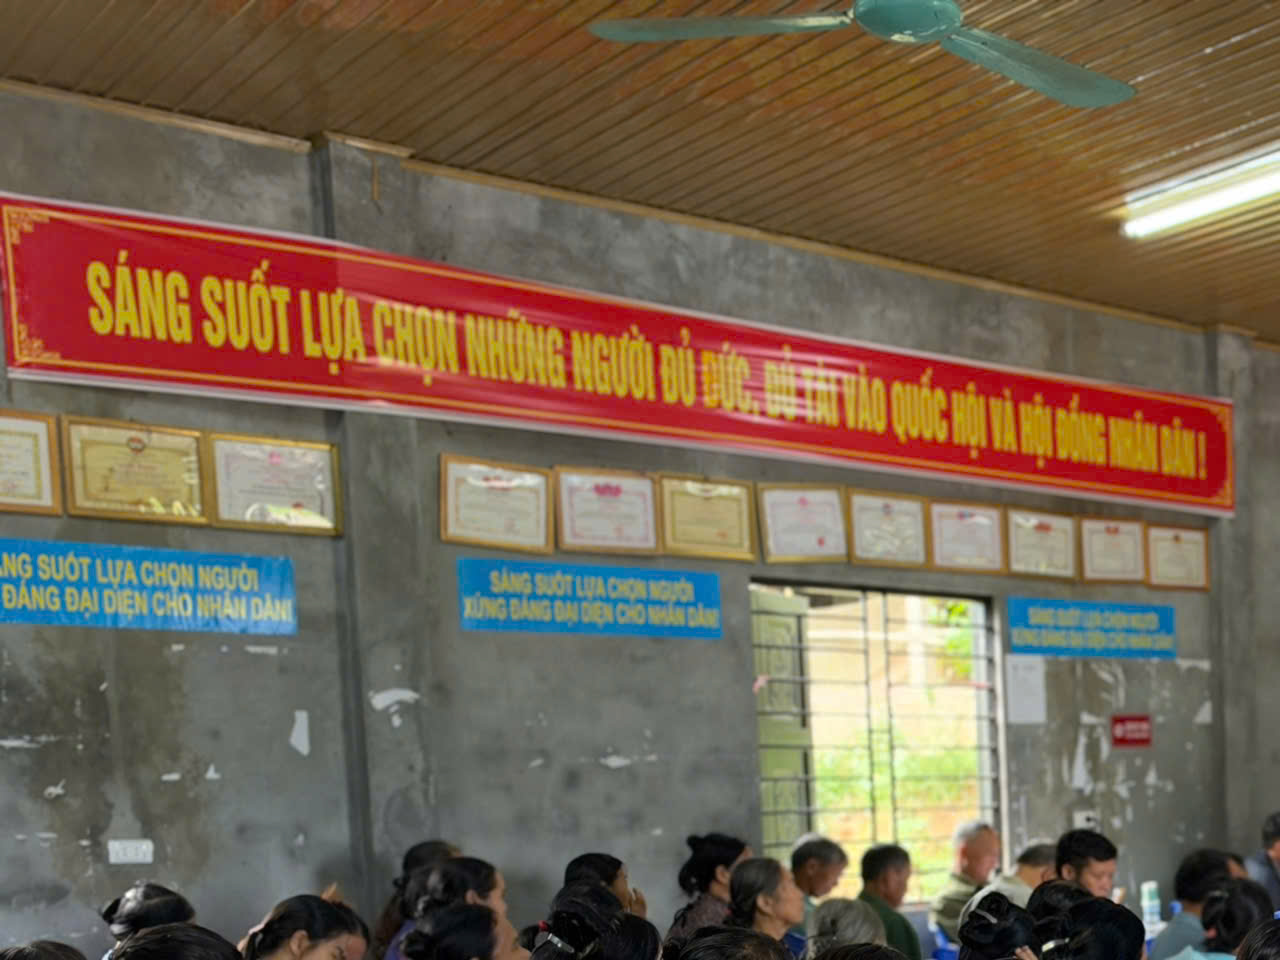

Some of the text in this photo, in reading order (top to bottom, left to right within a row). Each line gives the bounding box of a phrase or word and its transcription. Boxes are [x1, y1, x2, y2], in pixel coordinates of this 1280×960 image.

[86, 250, 192, 343] SÁNG
[201, 258, 291, 354] SUỐT
[300, 287, 368, 376] LỰA
[372, 299, 459, 387] CHỌN
[464, 307, 566, 388] NHỮNG
[570, 323, 655, 401] NGƯỜI
[659, 327, 696, 407] ĐỦ
[842, 362, 886, 434] VÀO
[891, 367, 948, 444] QUỐC
[951, 381, 987, 459] HỘI
[989, 388, 1018, 454] VÀ
[1018, 393, 1053, 469] HỘI
[1108, 410, 1158, 473] NHÂN
[152, 592, 193, 617] CHO
[197, 591, 247, 620] NHÂN
